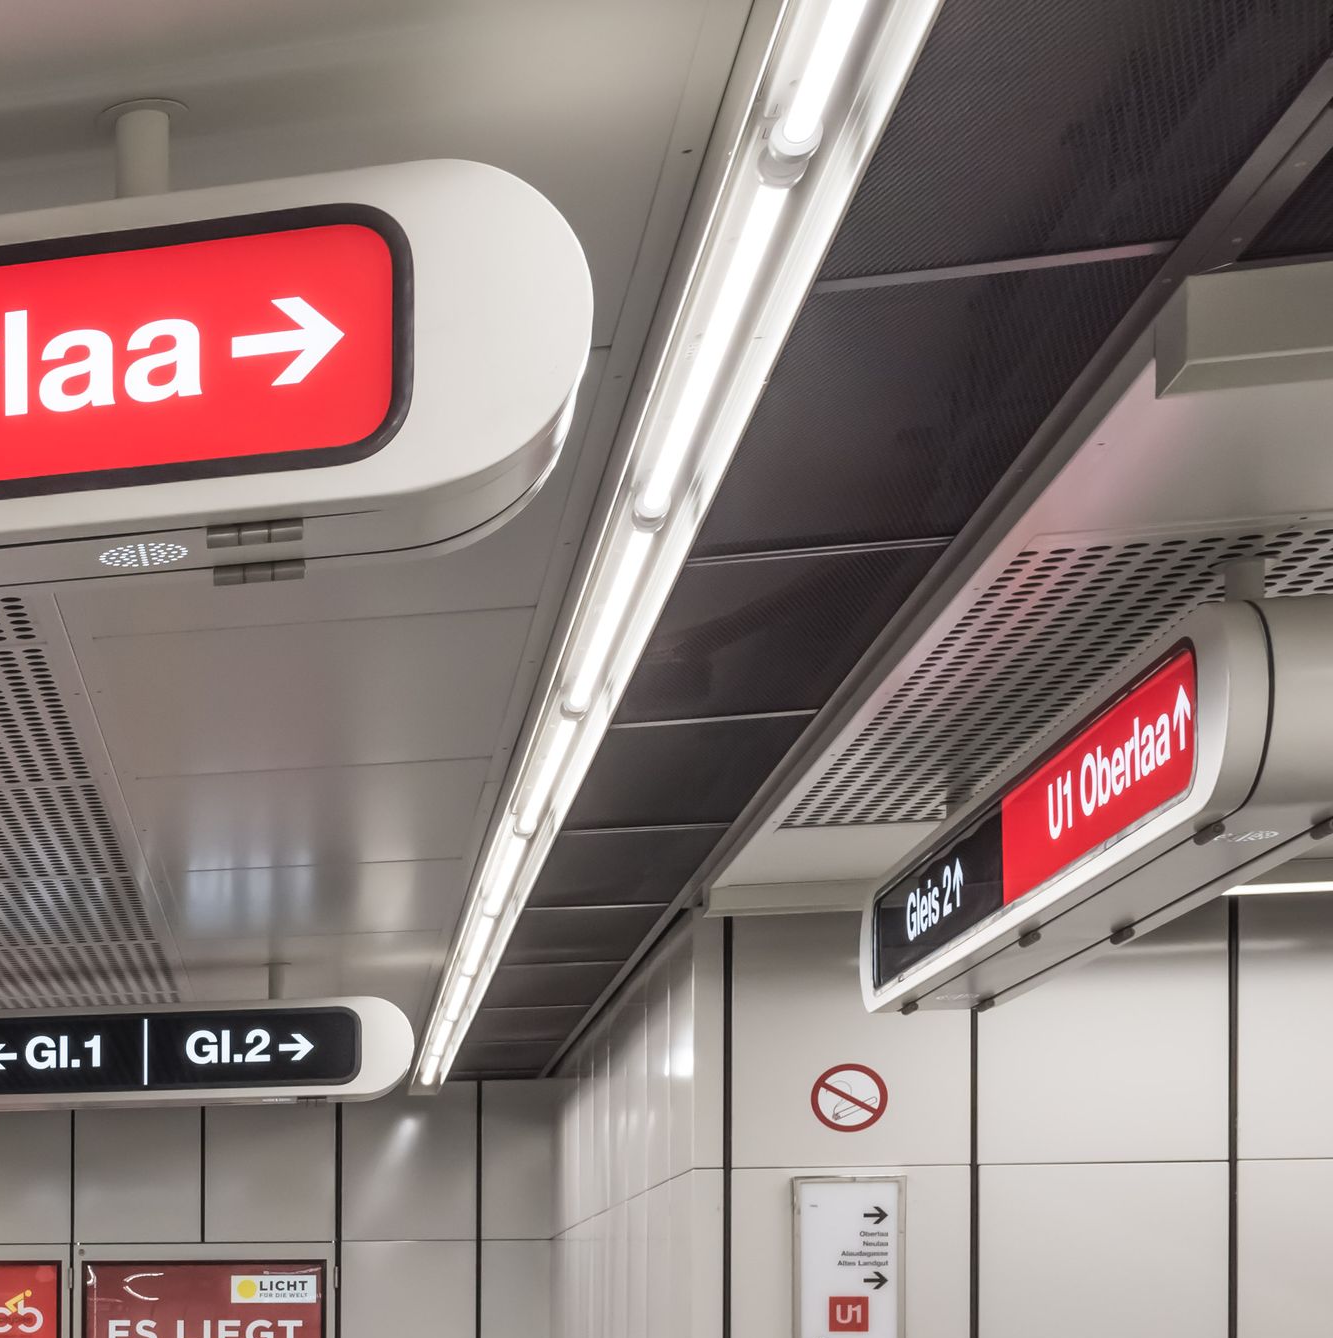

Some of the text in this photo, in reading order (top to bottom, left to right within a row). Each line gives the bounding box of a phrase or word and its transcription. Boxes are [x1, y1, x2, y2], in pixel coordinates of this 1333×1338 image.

[1047, 716, 1171, 840] U1 Oberlaa
[906, 865, 953, 942] Gleis 2
[25, 1034, 101, 1070] Gl.1
[185, 1029, 271, 1065] Gl.2
[858, 1260, 889, 1268] Landgut
[259, 1280, 308, 1291] LICHT
[835, 1303, 862, 1324] U1
